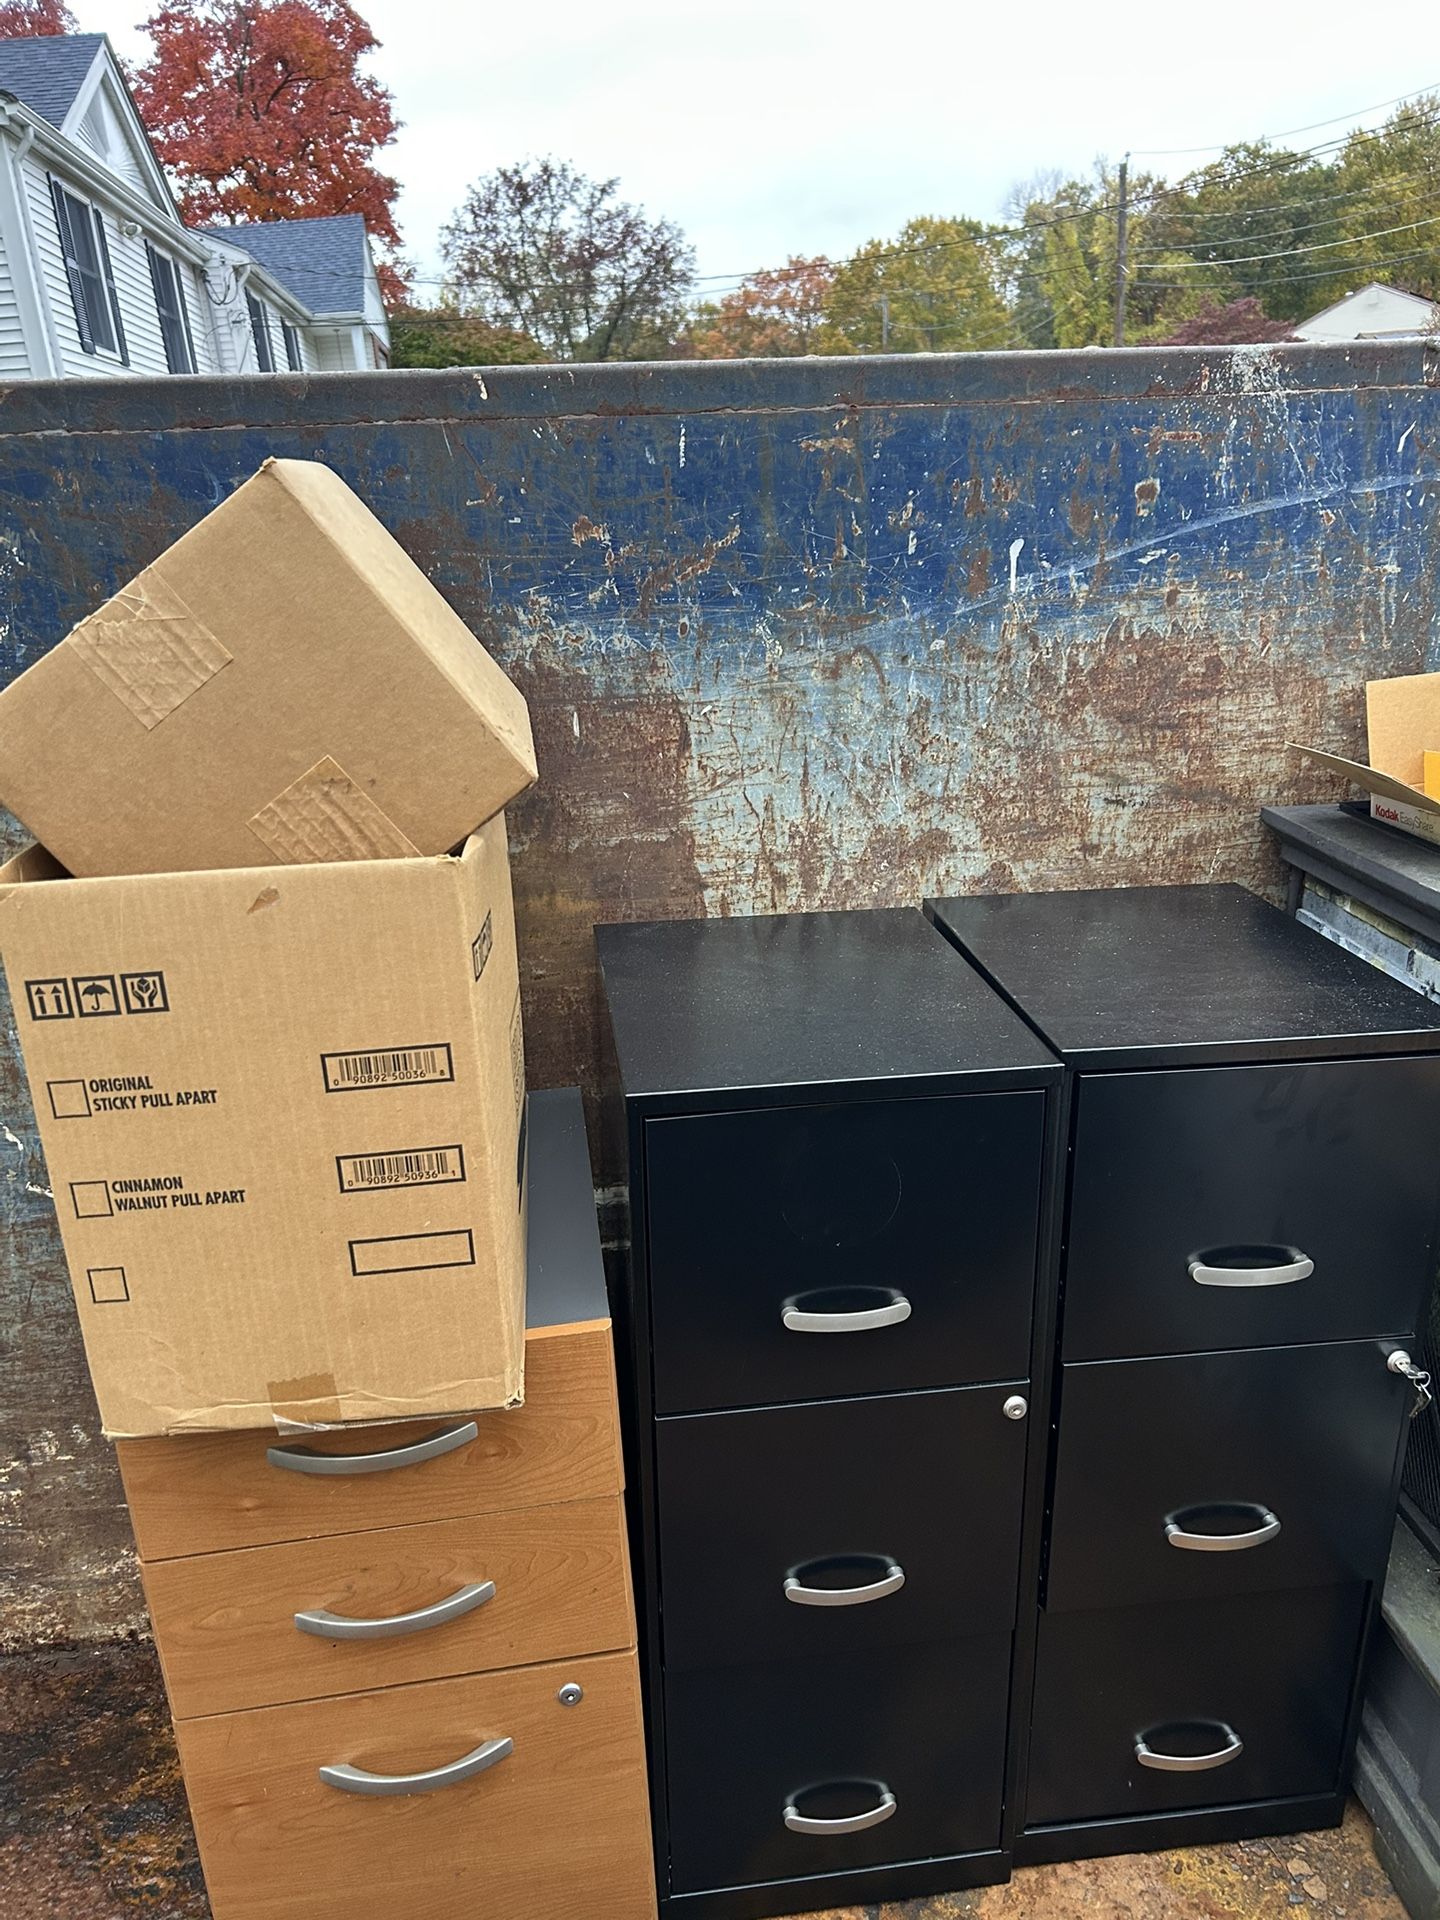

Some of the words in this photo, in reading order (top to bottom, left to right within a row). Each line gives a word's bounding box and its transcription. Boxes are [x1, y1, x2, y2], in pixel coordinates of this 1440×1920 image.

[1375, 804, 1399, 822] Kodak
[1400, 811, 1434, 833] EasyShare
[89, 1076, 153, 1093] ORIGINAL
[353, 1073, 387, 1085] 90892
[392, 1070, 426, 1081] 50036
[93, 1096, 137, 1112] STICKY
[141, 1093, 173, 1108] PULL
[176, 1090, 218, 1106] APART
[112, 1176, 183, 1194] CINNAMON
[367, 1174, 400, 1185] 90892
[404, 1170, 438, 1181] 50936
[115, 1195, 168, 1212] WALNUT
[172, 1193, 202, 1208] PULL
[205, 1190, 246, 1206] APART
